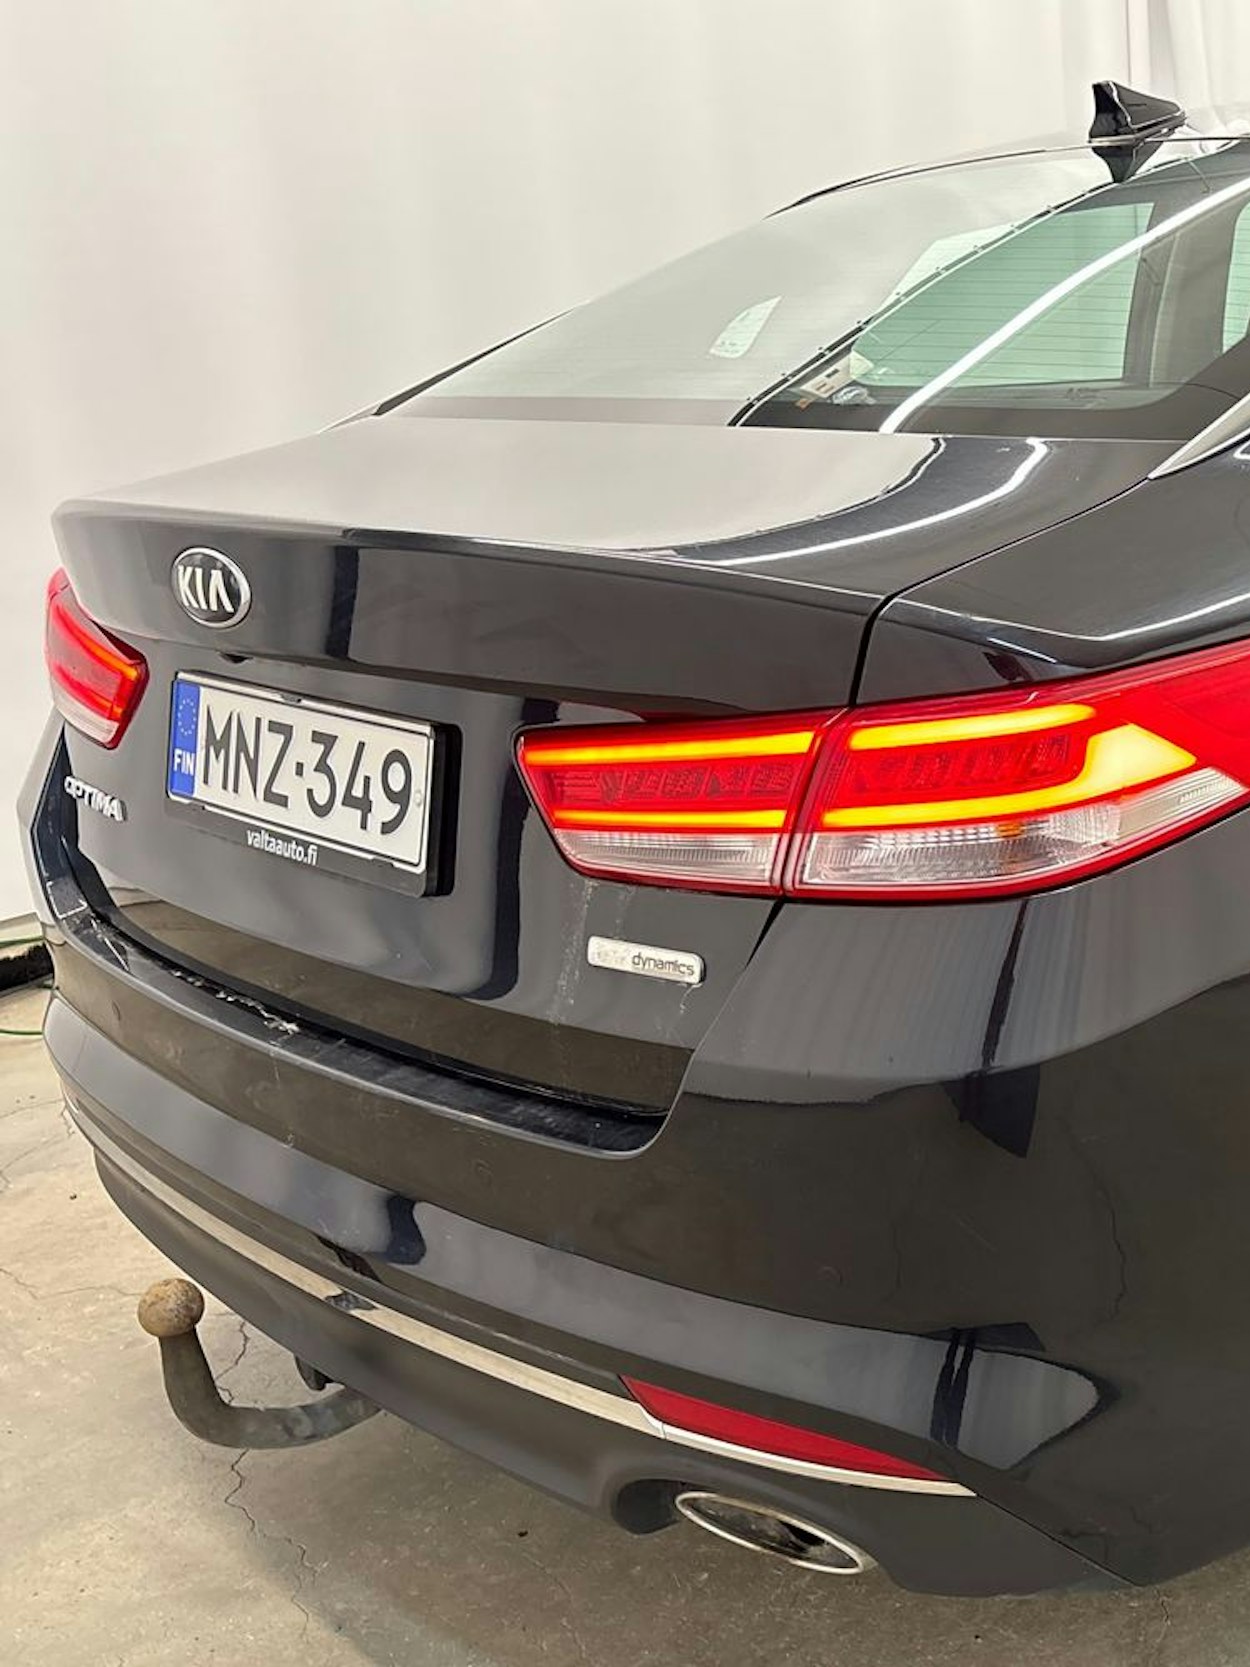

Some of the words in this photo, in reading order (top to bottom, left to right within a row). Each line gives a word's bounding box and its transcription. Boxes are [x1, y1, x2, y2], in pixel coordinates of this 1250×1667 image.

[178, 565, 234, 613] KIA
[174, 750, 195, 775] FIN
[64, 776, 124, 822] OPTIMA
[246, 829, 318, 866] valtaauto.fi
